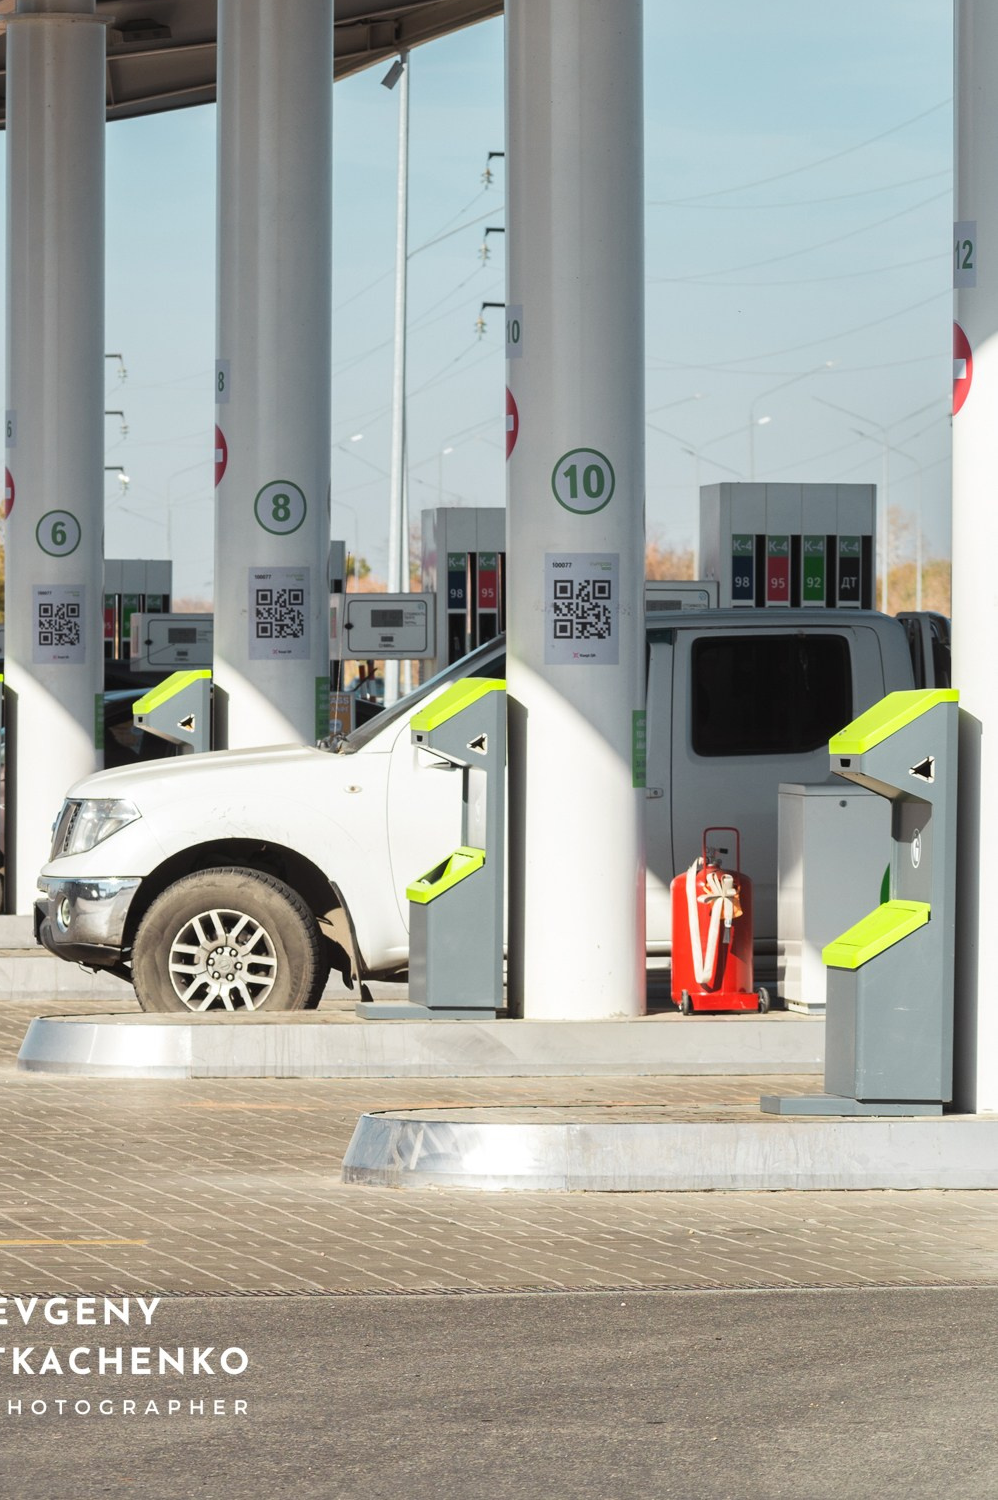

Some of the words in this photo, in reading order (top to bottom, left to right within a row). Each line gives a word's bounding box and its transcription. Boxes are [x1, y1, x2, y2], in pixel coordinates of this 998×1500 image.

[955, 239, 973, 270] 12
[506, 319, 520, 344] 10
[218, 371, 224, 392] 8
[7, 420, 12, 438] 6
[563, 464, 605, 498] 10
[272, 493, 291, 522] 8
[51, 521, 67, 546] 6
[735, 576, 750, 588] 98
[771, 578, 785, 589] 95
[806, 577, 822, 588] 92
[841, 576, 858, 589] ДТ
[450, 588, 464, 599] 98
[481, 588, 494, 598] 95
